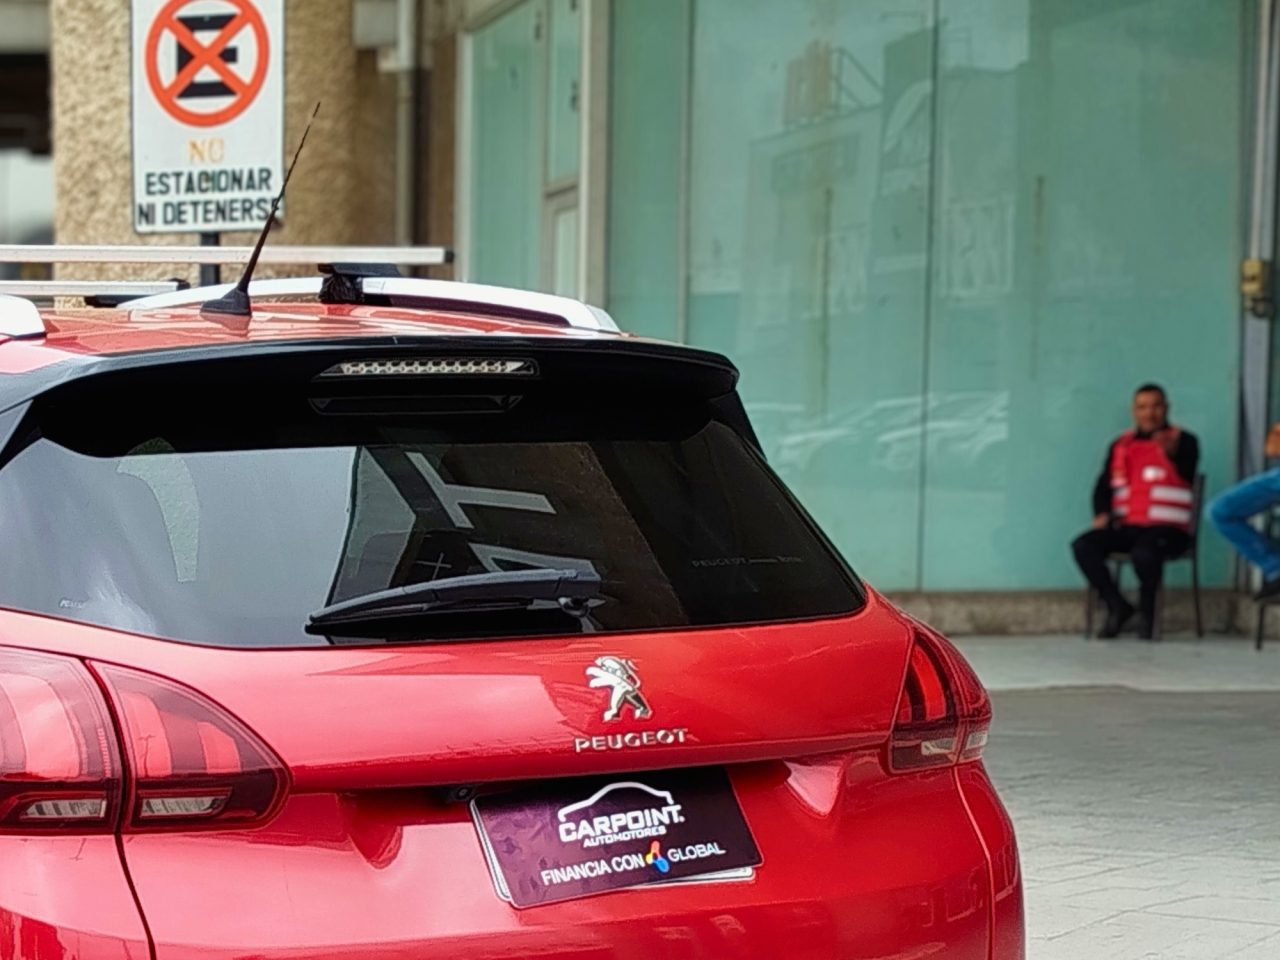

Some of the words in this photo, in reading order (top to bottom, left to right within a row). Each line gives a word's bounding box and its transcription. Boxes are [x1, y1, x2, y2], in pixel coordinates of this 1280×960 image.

[187, 137, 225, 164] NO
[145, 167, 273, 196] ESTACIONAR
[137, 202, 156, 226] NI
[574, 728, 688, 752] PEUGEOT
[583, 825, 667, 848] AUTOMOTORES
[541, 859, 610, 886] FINANCIA
[611, 853, 646, 874] CON
[667, 842, 726, 863] GLOBAL
